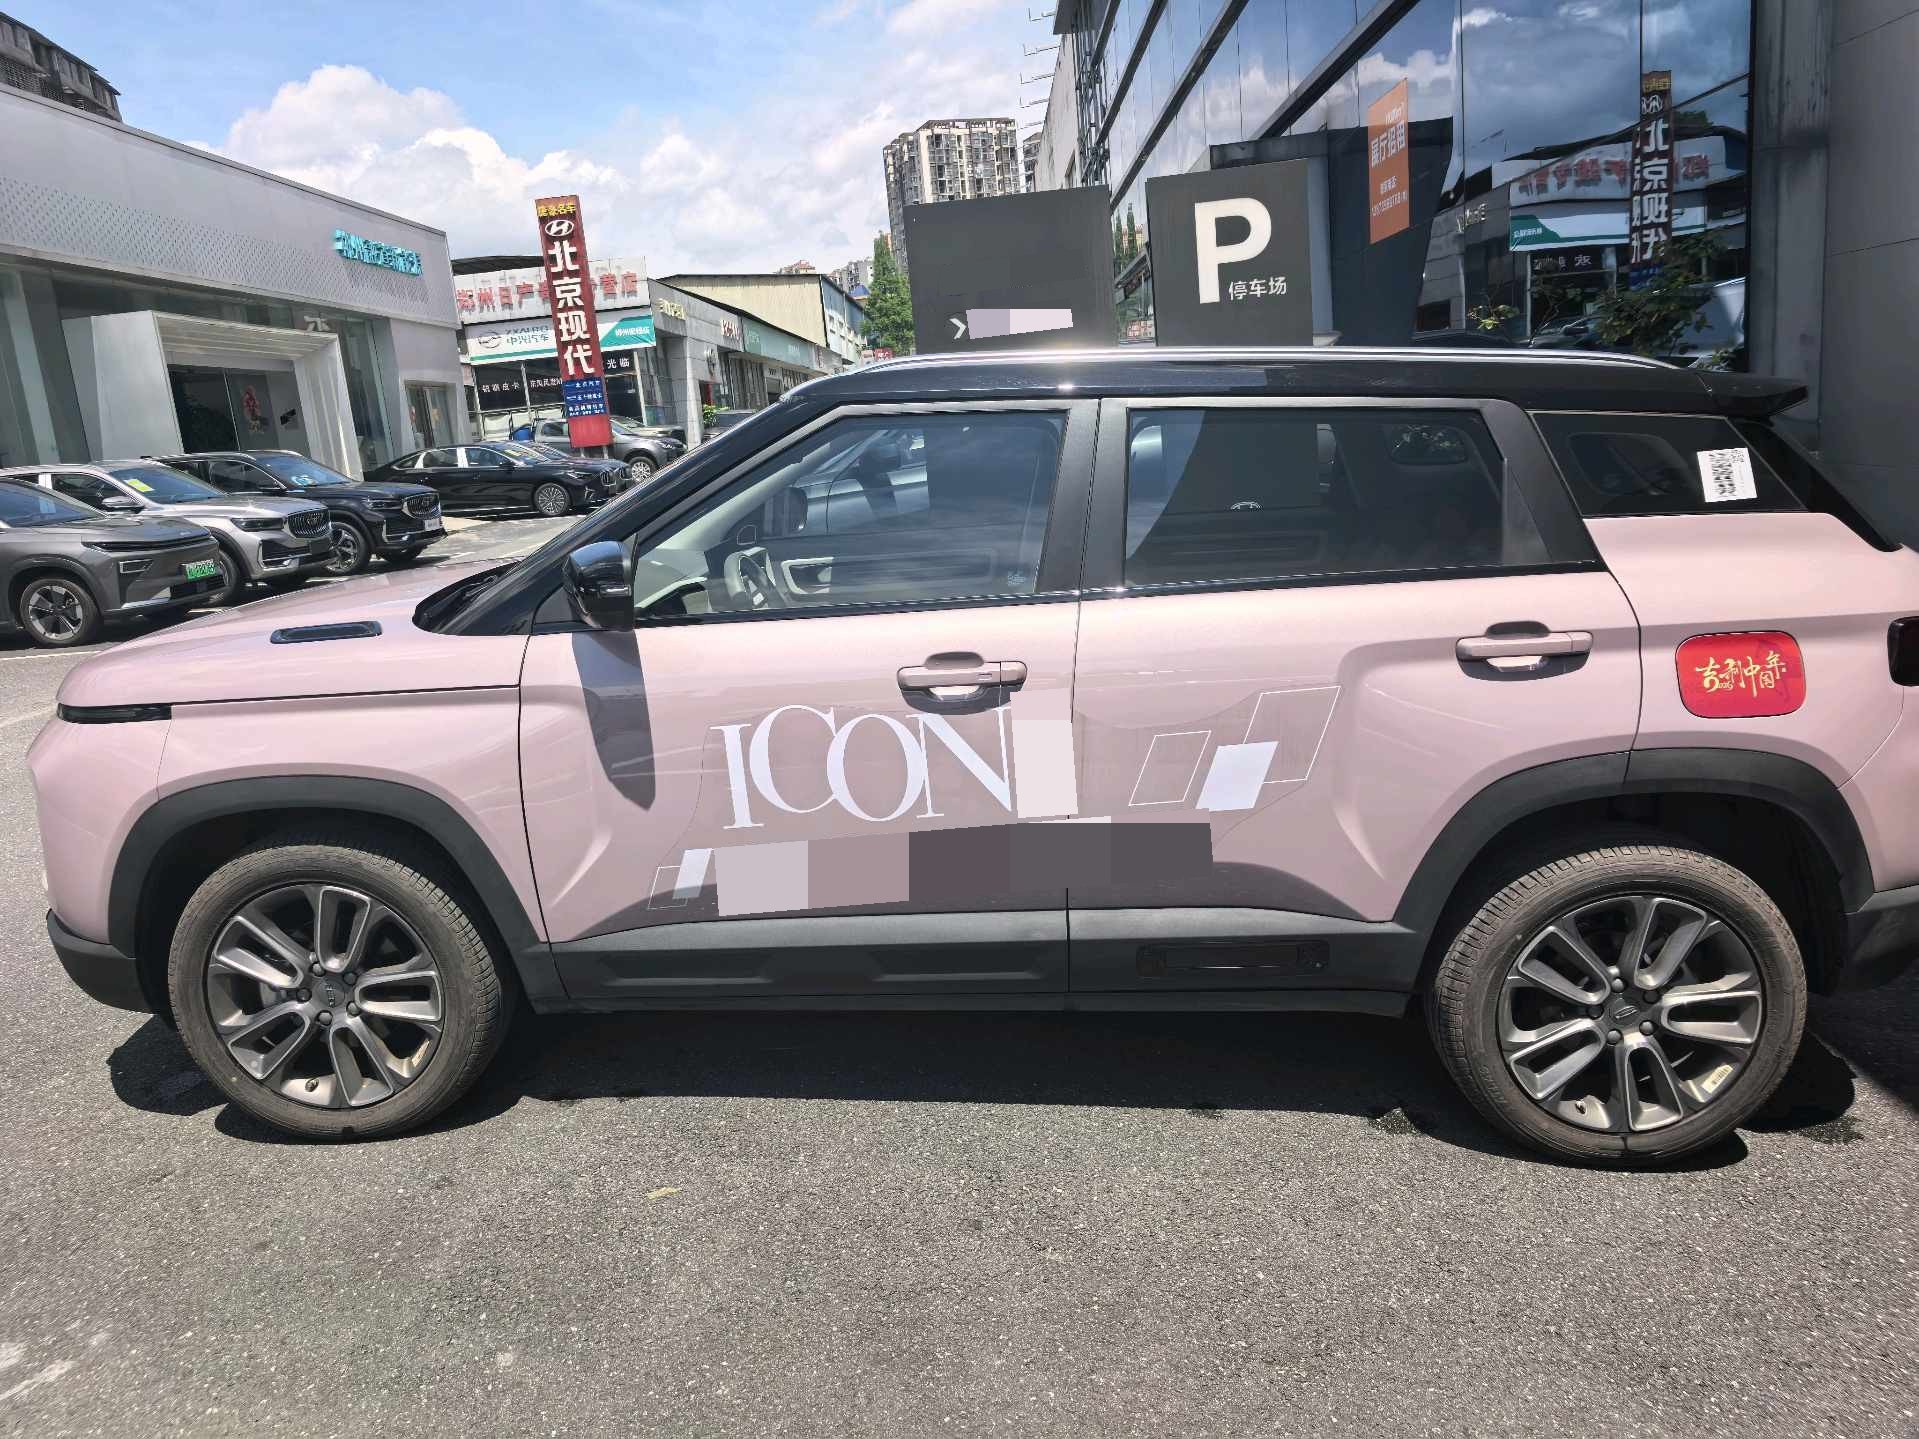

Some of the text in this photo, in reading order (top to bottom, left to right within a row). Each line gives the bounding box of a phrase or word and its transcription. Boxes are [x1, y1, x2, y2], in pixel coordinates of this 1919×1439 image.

[1371, 120, 1406, 168] 展厅招租
[1194, 197, 1272, 304] P
[547, 240, 596, 376] 北京现代
[1228, 277, 1287, 300] 停车场
[606, 357, 630, 369] 光临
[1695, 650, 1787, 698] 吉利中国年
[709, 704, 1014, 829] ICON
